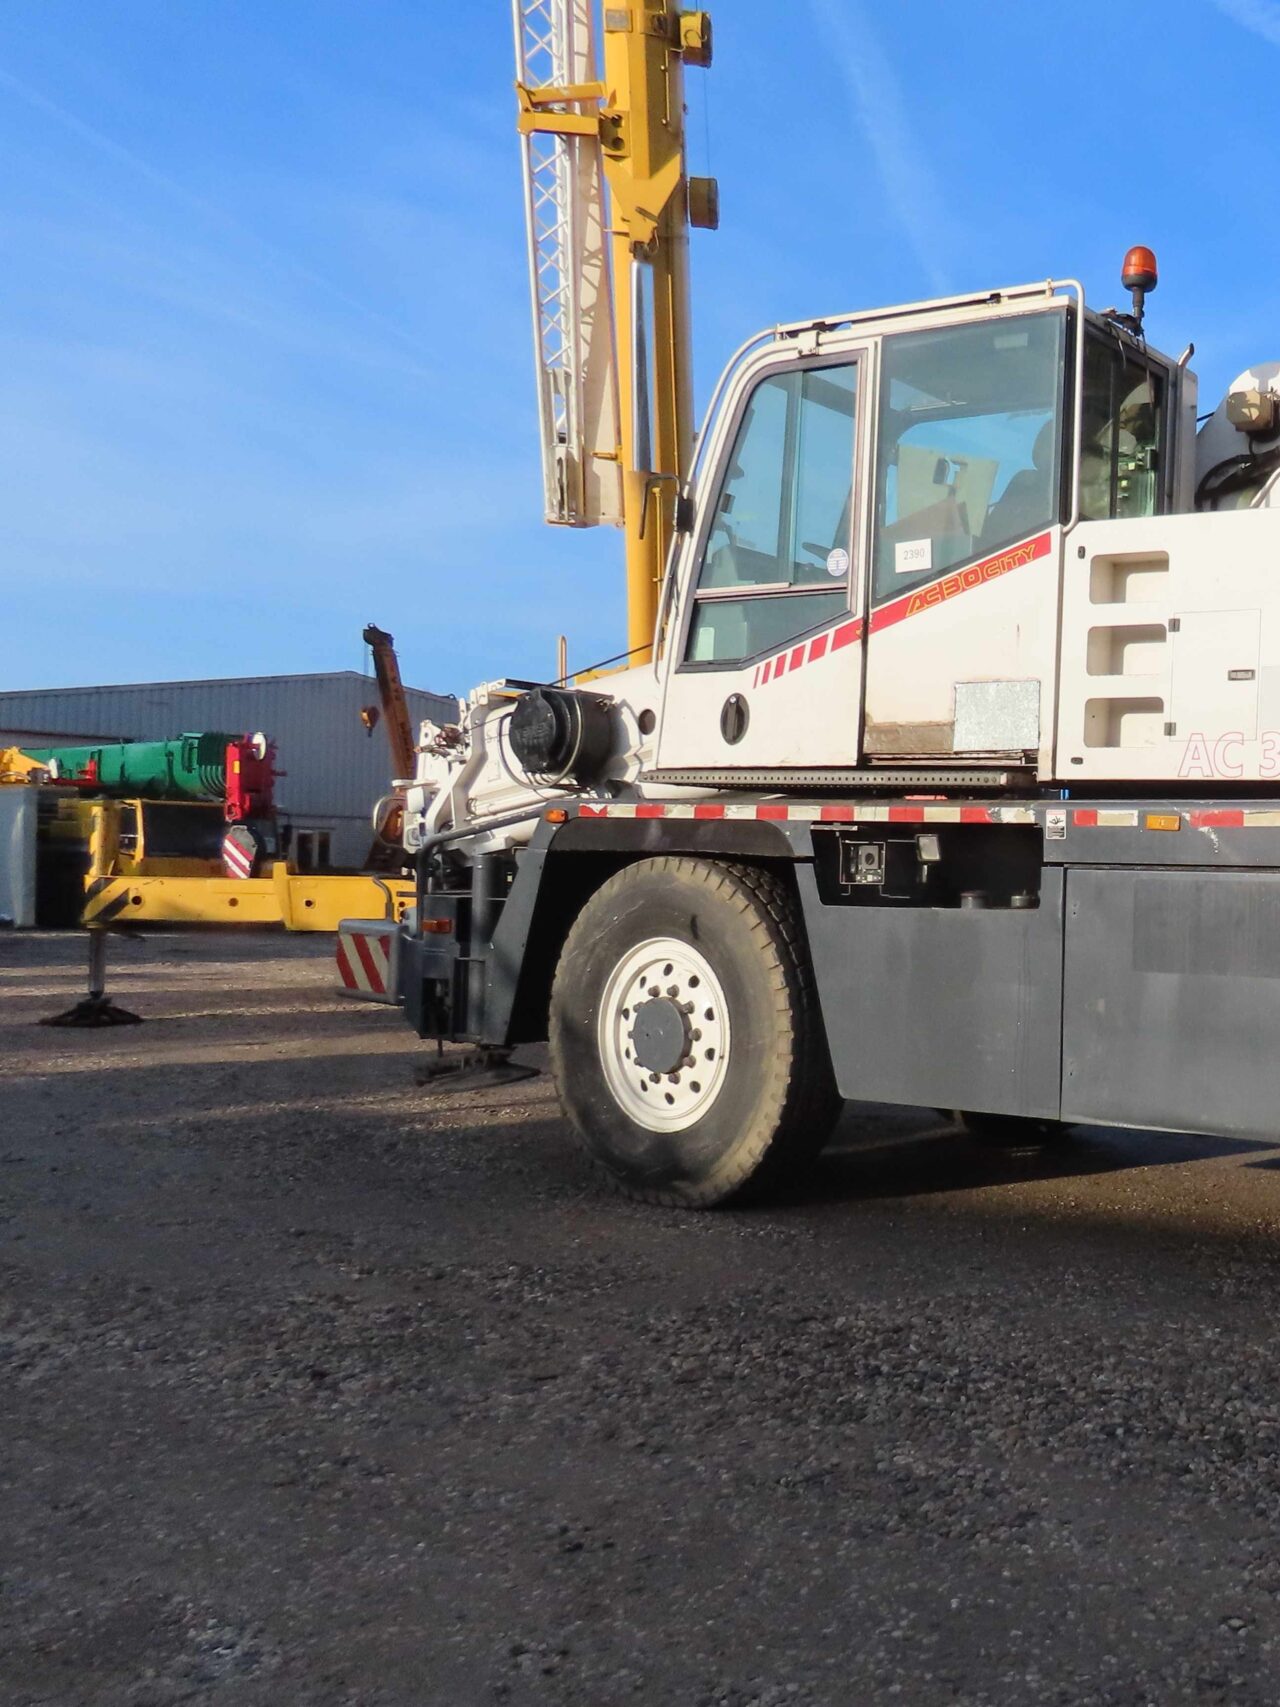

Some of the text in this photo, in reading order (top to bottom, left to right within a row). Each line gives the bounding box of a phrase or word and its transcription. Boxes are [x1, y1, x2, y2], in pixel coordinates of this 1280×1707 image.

[903, 548, 925, 560] 2390
[984, 544, 1036, 580] CITY
[1177, 731, 1244, 778] AC
